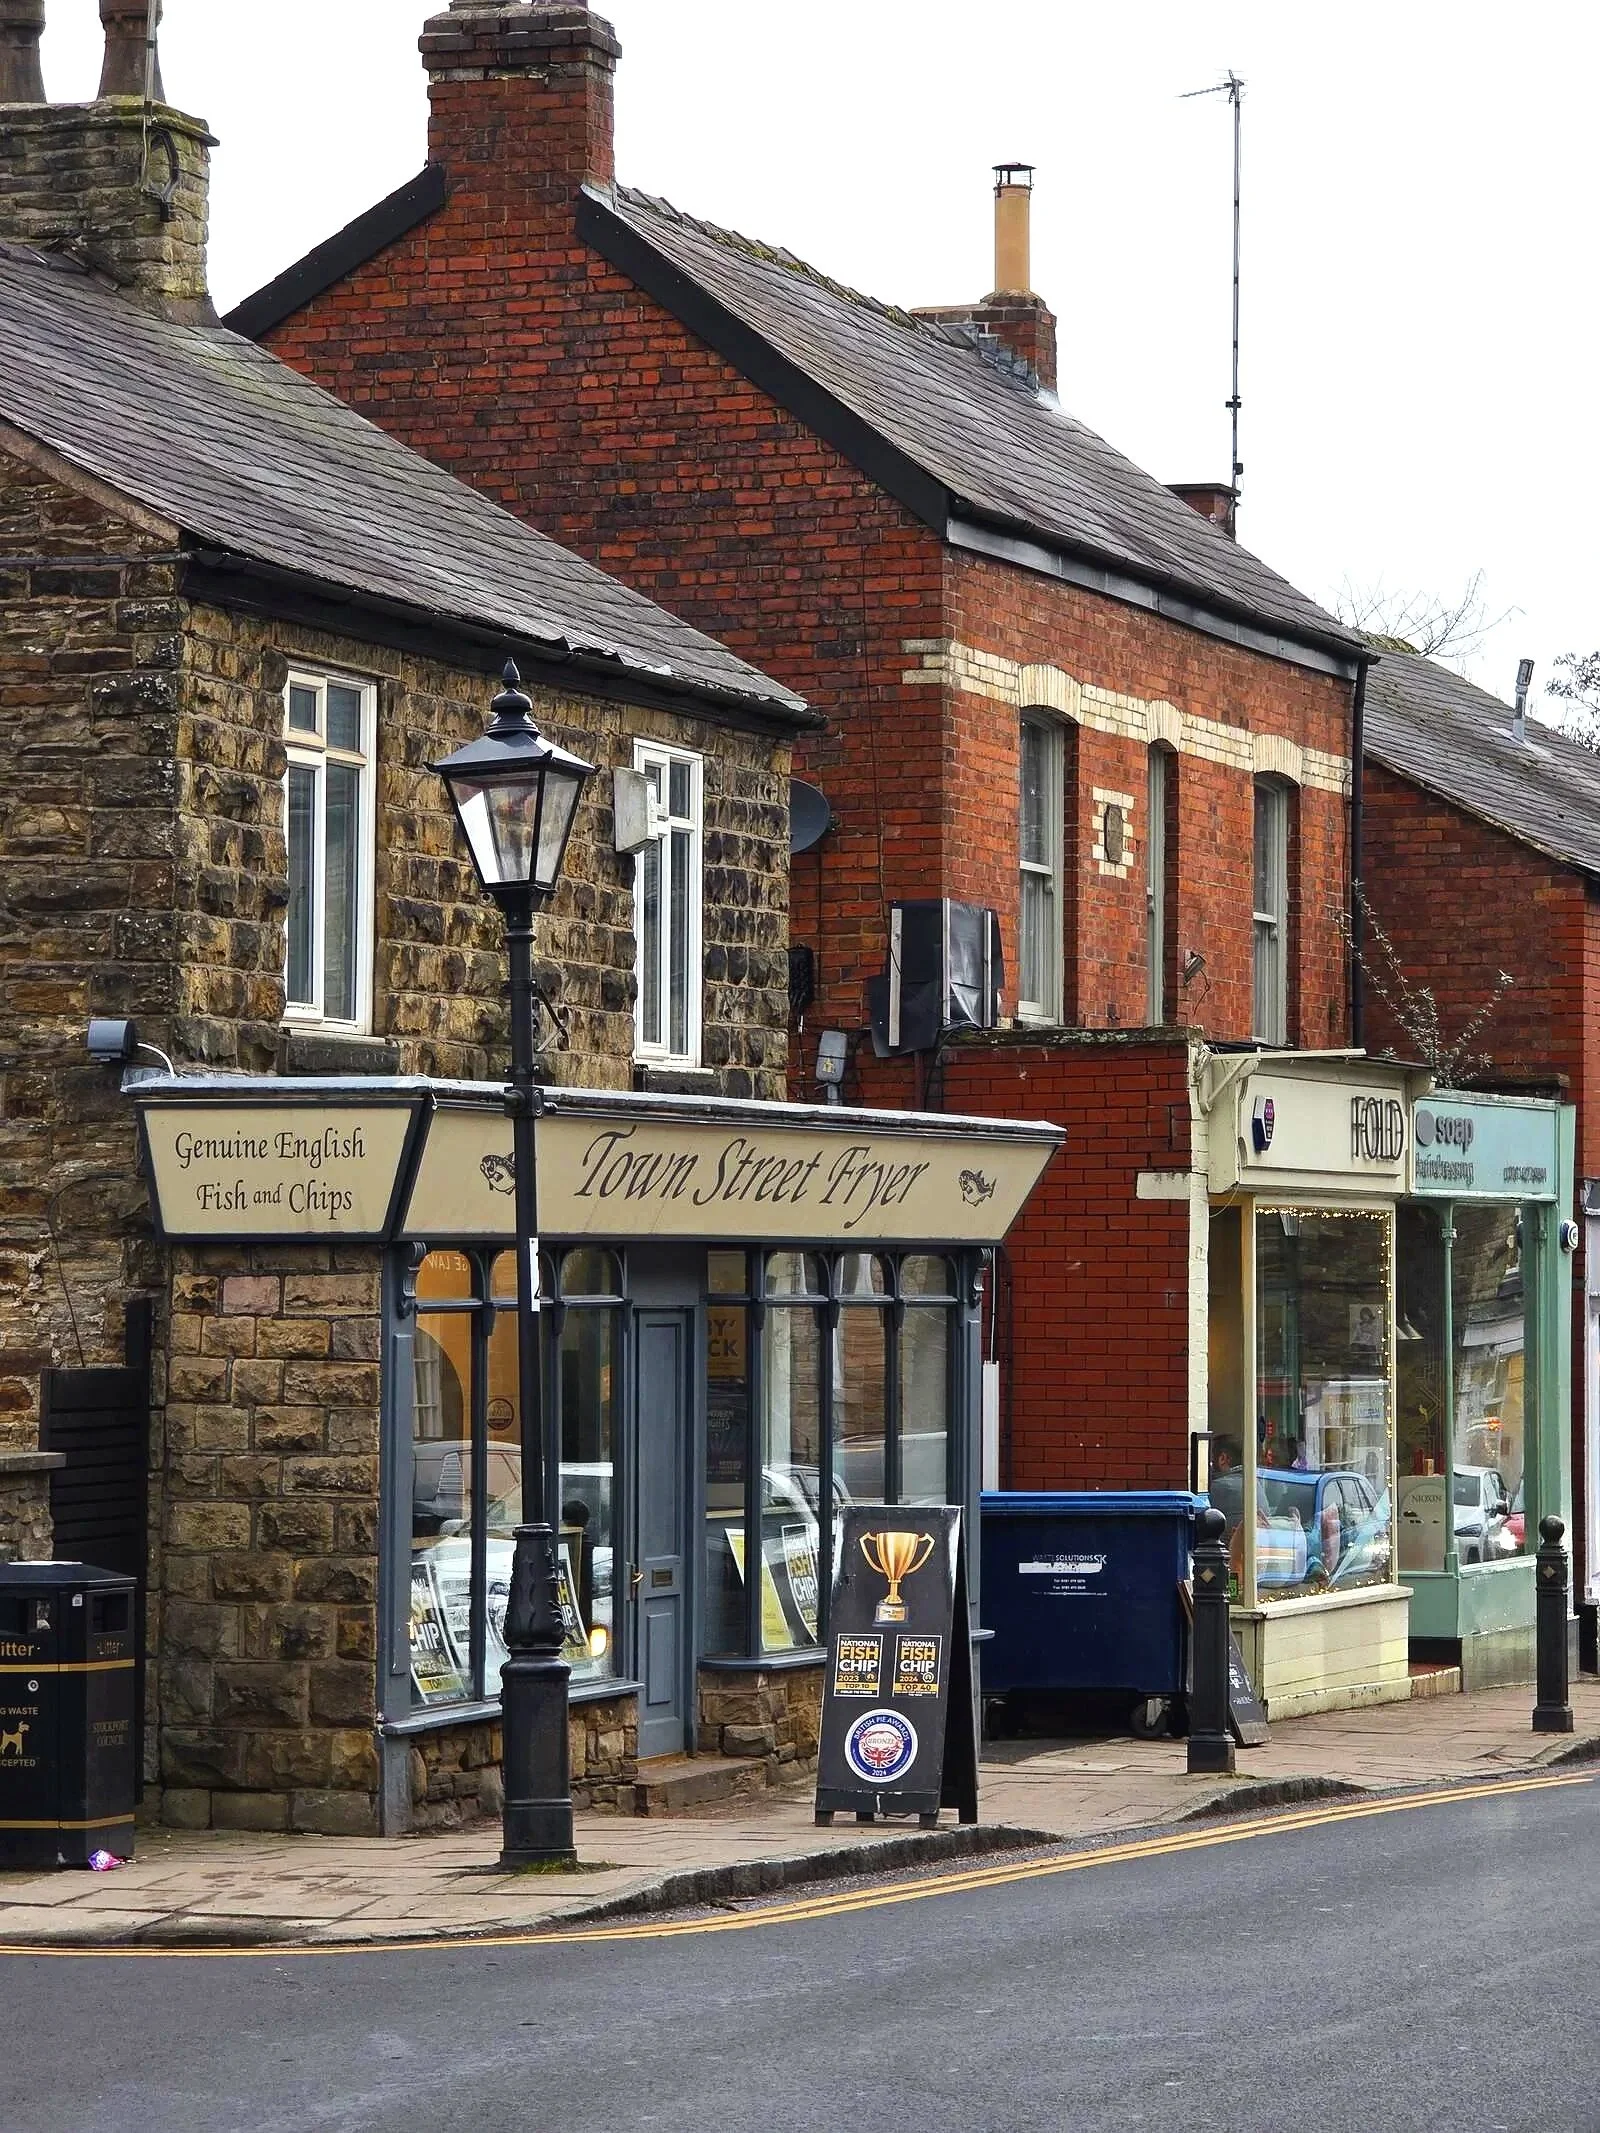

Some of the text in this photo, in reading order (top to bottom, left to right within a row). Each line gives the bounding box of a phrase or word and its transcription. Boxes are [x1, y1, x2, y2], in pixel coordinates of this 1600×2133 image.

[1351, 1096, 1404, 1161] FOLD
[1435, 1116, 1474, 1155] soap
[175, 1127, 366, 1169] Genuine English
[573, 1124, 930, 1229] Town Street Fryer
[197, 1179, 353, 1220] Fish and Chips
[839, 1659, 878, 1672] CHIP
[840, 1647, 879, 1660] FISH
[900, 1647, 936, 1661] FISH
[900, 1660, 935, 1672] CHIP
[9, 1706, 39, 1716] WASTE
[853, 1717, 876, 1740] BRITISH
[887, 1717, 910, 1741] AWARDS
